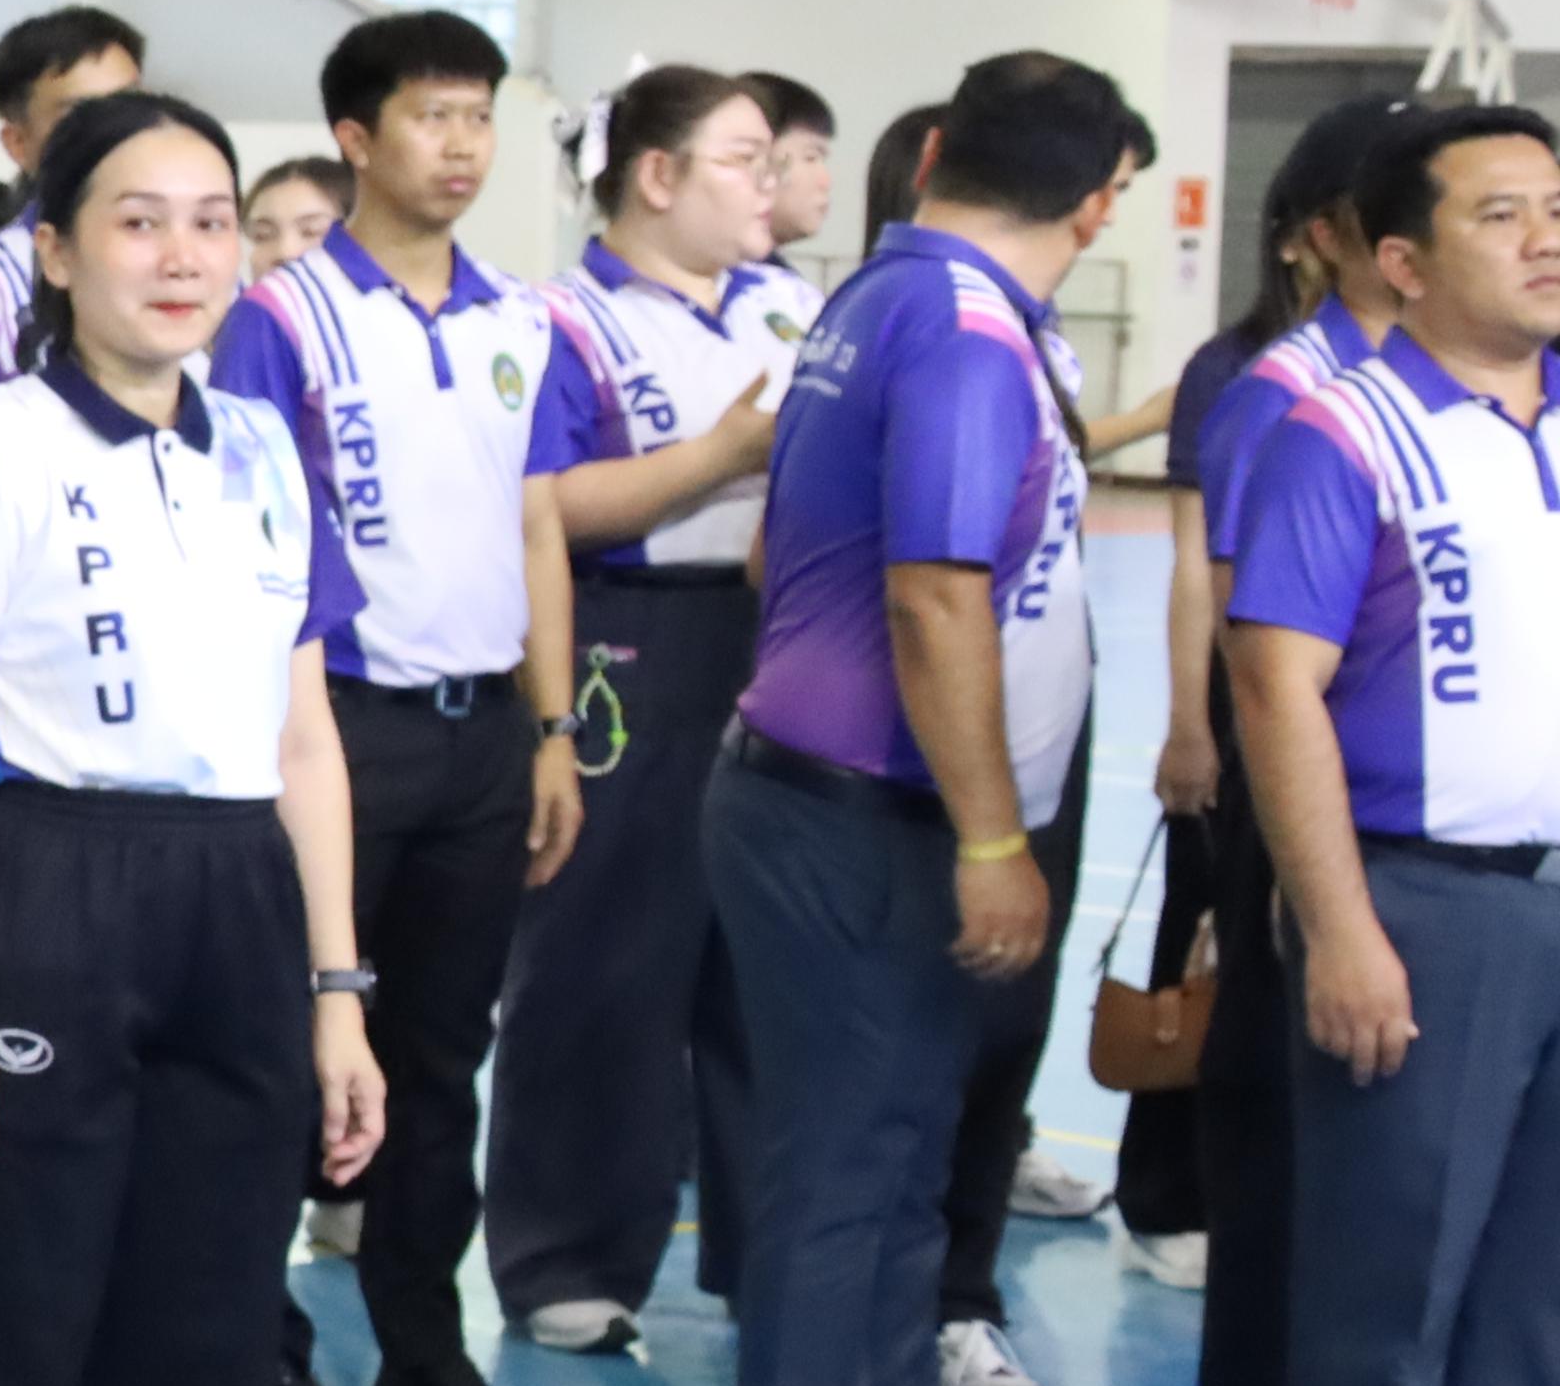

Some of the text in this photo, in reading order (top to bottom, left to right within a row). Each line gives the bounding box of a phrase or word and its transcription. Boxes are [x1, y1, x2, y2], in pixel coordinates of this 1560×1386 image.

[332, 401, 387, 549] KPRU
[63, 480, 136, 725] KPRU
[1416, 523, 1481, 704] KPRU
